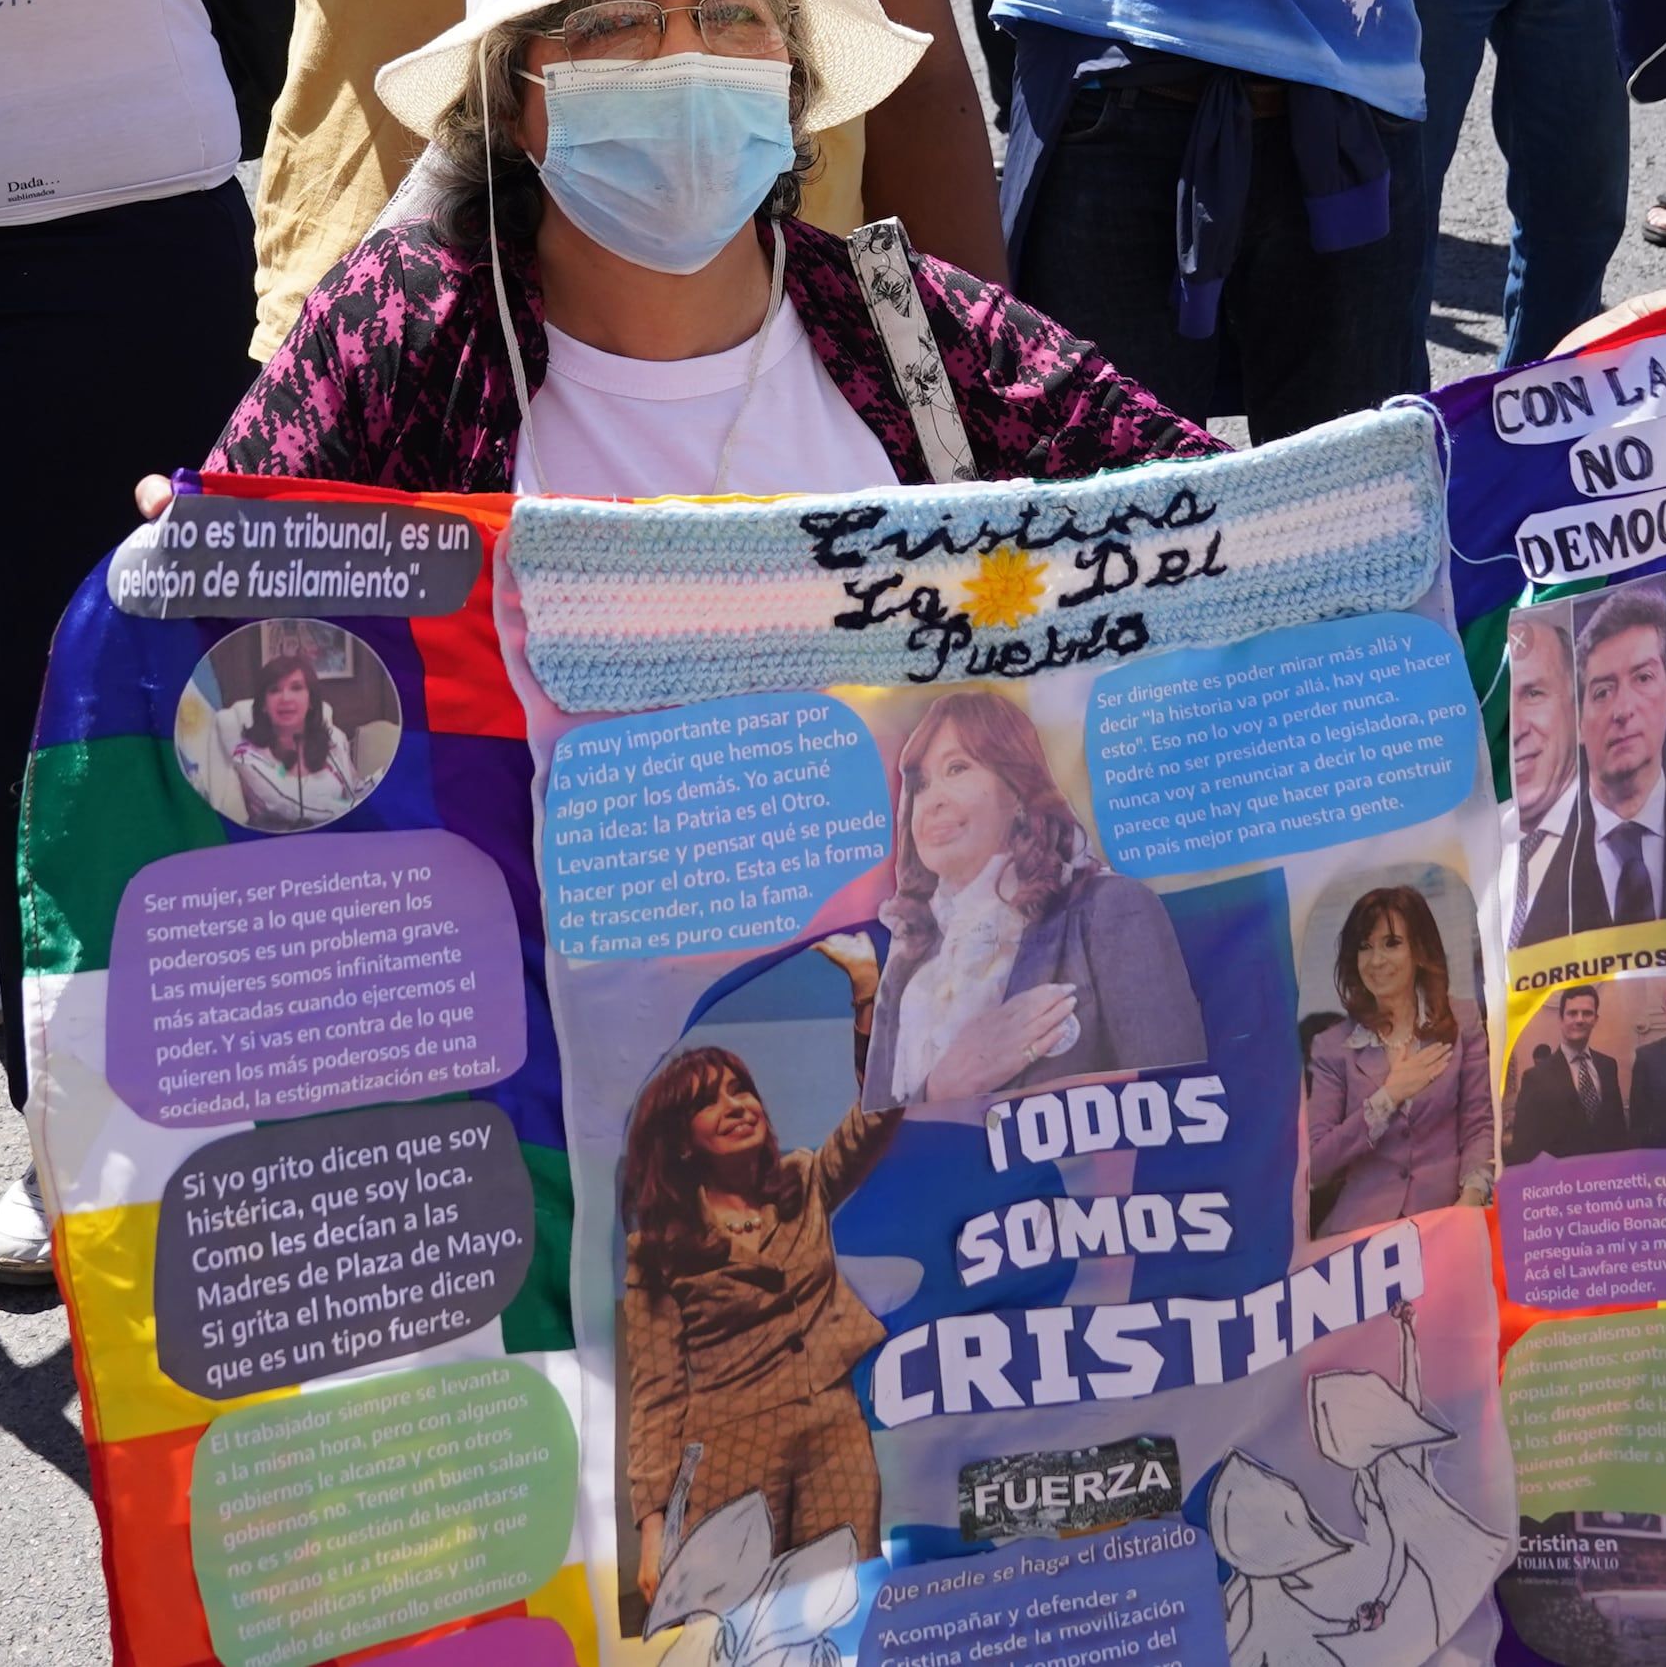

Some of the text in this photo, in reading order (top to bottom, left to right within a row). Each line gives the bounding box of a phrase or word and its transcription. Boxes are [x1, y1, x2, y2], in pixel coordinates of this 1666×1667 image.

[1494, 374, 1593, 435] CON
[1575, 435, 1653, 495] NO
[162, 519, 198, 549] no
[205, 522, 234, 549] es
[244, 521, 277, 550] un
[284, 511, 393, 557] tribunal,
[400, 523, 430, 551] es
[438, 523, 470, 551] un
[119, 561, 196, 604] pelotón
[203, 562, 239, 598] de
[833, 530, 1227, 630] La Del
[908, 611, 1150, 682] Pueblo
[1096, 635, 1412, 709] Ser dirigente es poder mirar más allá y
[576, 764, 620, 787] vida
[624, 765, 636, 784] y
[642, 756, 685, 777] decir
[690, 750, 724, 773] que
[728, 739, 794, 762] hemos
[798, 730, 858, 752] hecho
[578, 737, 622, 757] muy
[627, 717, 732, 751] importante
[737, 711, 790, 737] pasar
[796, 706, 830, 729] por
[144, 866, 432, 913] Ser mujer, ser Presidenta, y no
[146, 891, 433, 943] someterse a lo que quieren los
[986, 1075, 1230, 1174] TODOS
[182, 1125, 492, 1200] Si yo grito dicen que soy
[1522, 1179, 1574, 1201] Ricardo
[1576, 1172, 1652, 1194] Lorenzetti,
[186, 1167, 473, 1237] histérica, que soy loca.
[192, 1202, 459, 1273] Como les decían a las
[197, 1228, 523, 1311] Madres de Plaza de Mayo.
[957, 1191, 1234, 1288] SOMOS
[201, 1269, 495, 1349] Si grita el hombre dicen
[874, 1218, 1425, 1429] CRISTINA
[206, 1308, 471, 1387] que es un tipo fuerte.
[210, 1369, 510, 1455] El trabajador siempre se levanta
[973, 1460, 1173, 1518] FUERZA
[876, 1525, 1196, 1610] Que nadie se haga el distraido
[1519, 1533, 1618, 1553] Cristina en
[1008, 1607, 1020, 1628] y
[1026, 1589, 1119, 1619] defender
[1126, 1589, 1137, 1600] a
